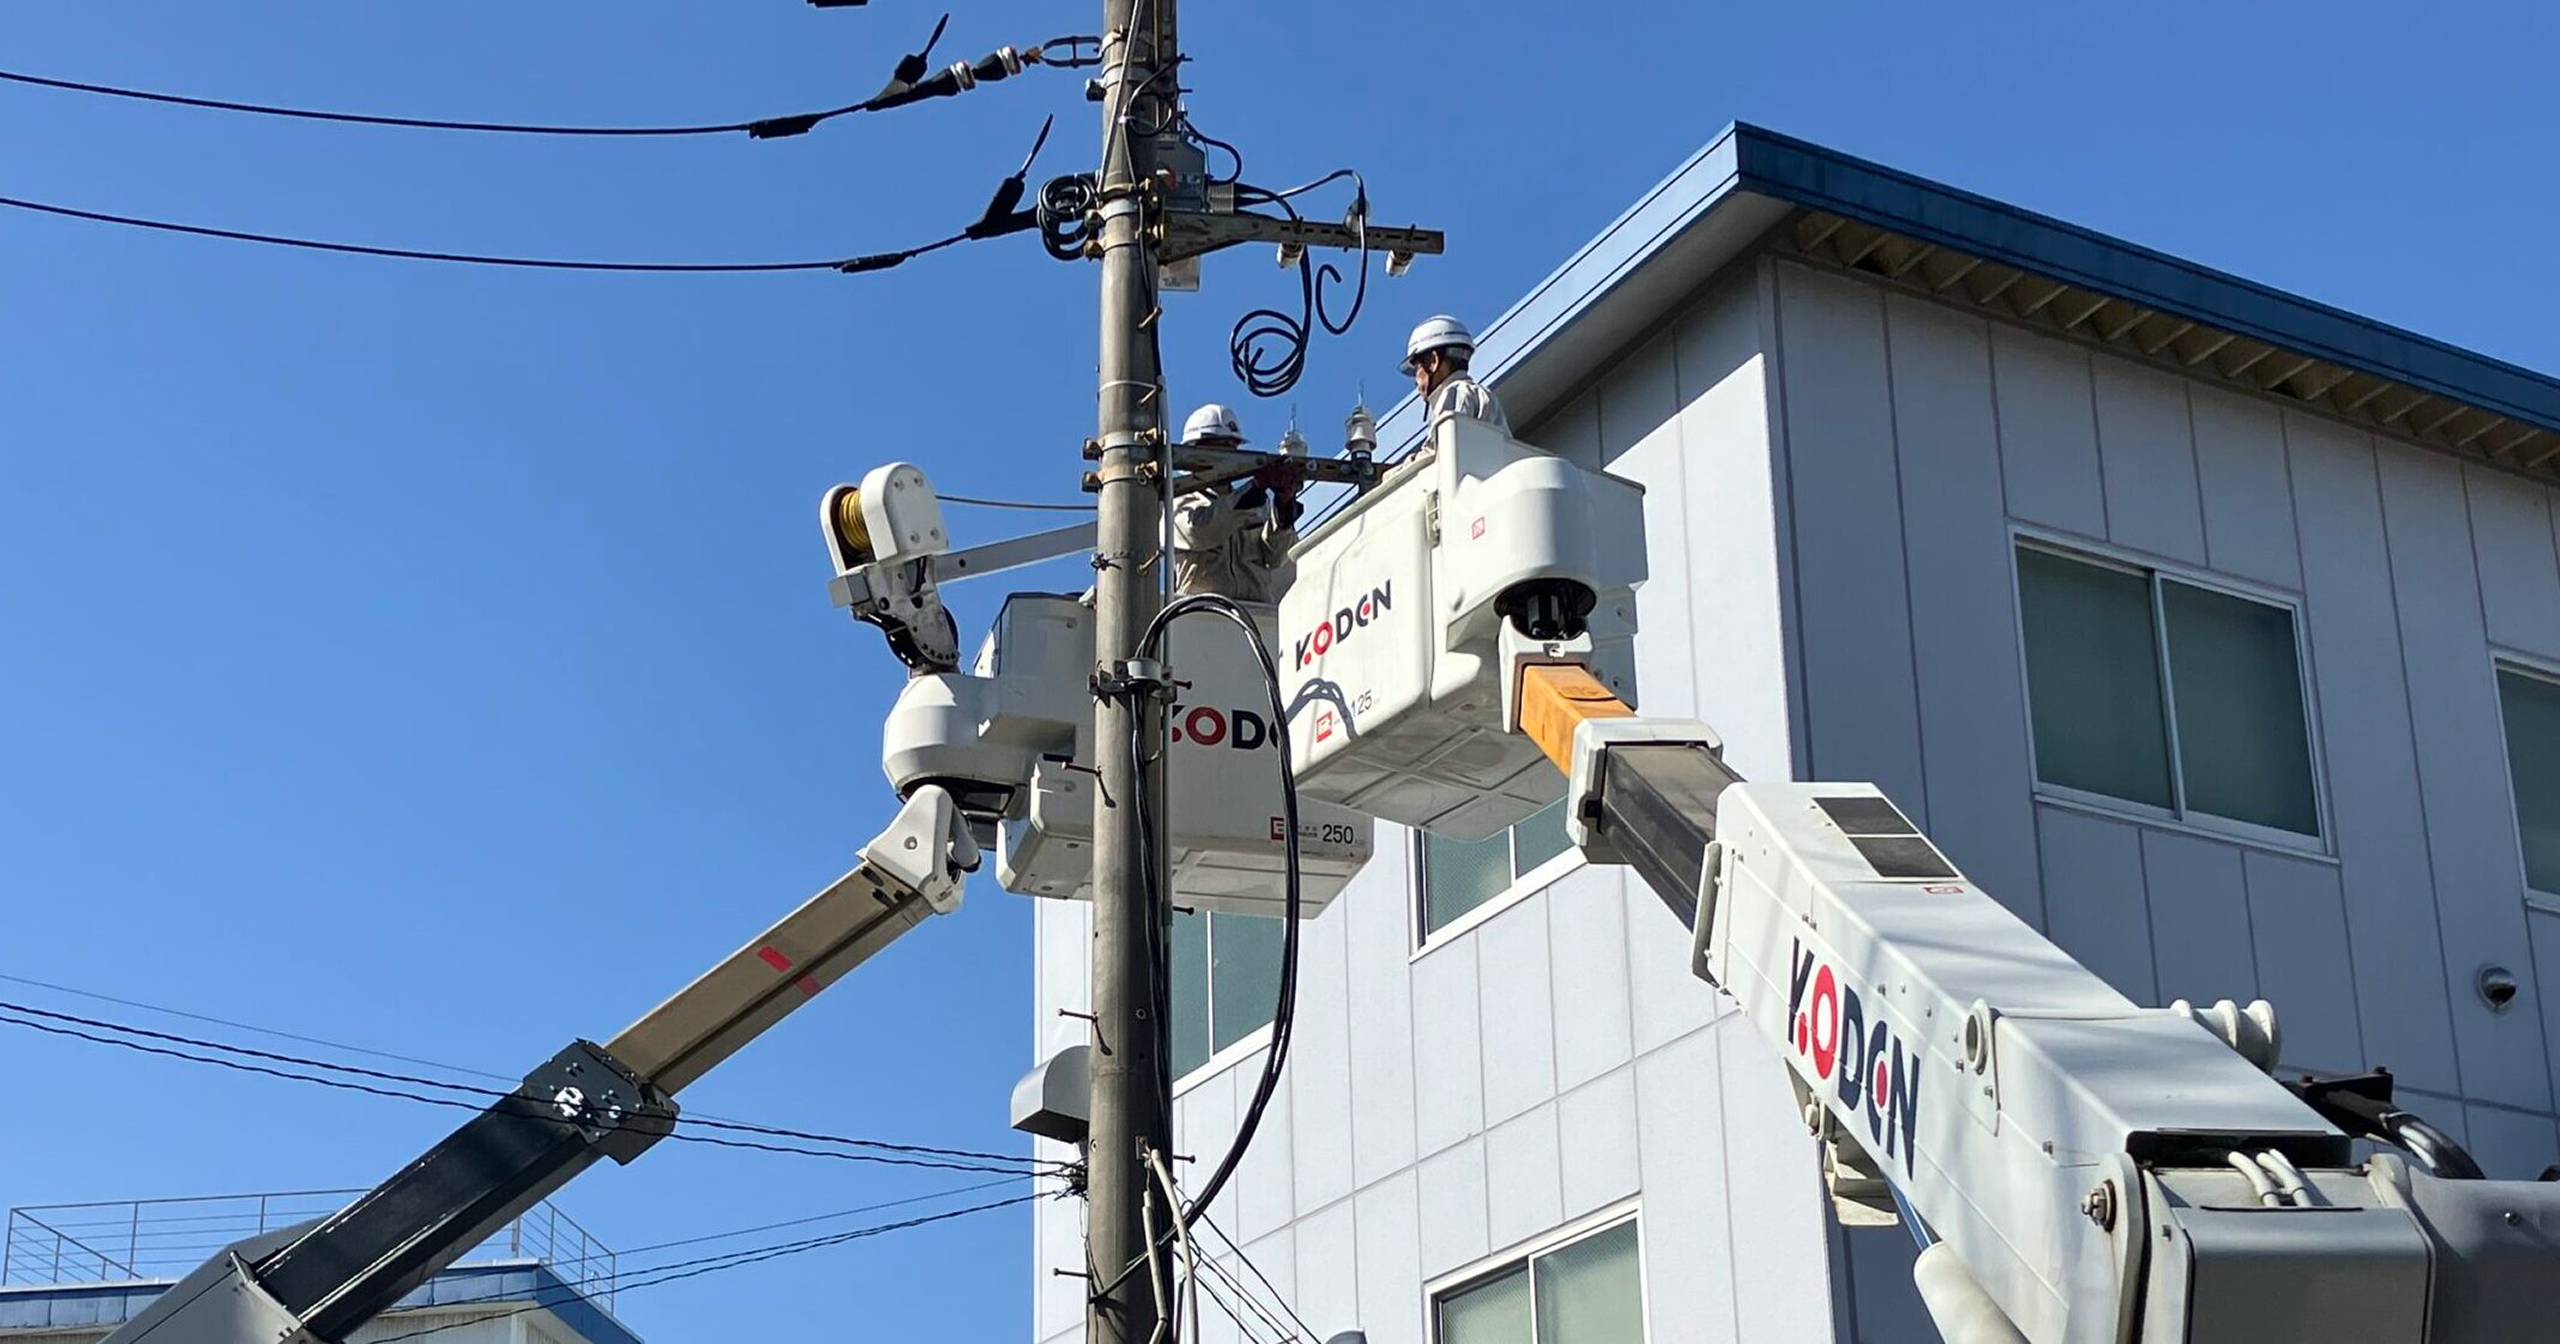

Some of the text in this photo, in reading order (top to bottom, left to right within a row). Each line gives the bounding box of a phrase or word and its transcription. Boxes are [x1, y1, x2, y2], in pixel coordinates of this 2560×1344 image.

[1351, 690, 1372, 717] 125
[1172, 705, 1278, 750] OD
[1322, 824, 1354, 844] 250
